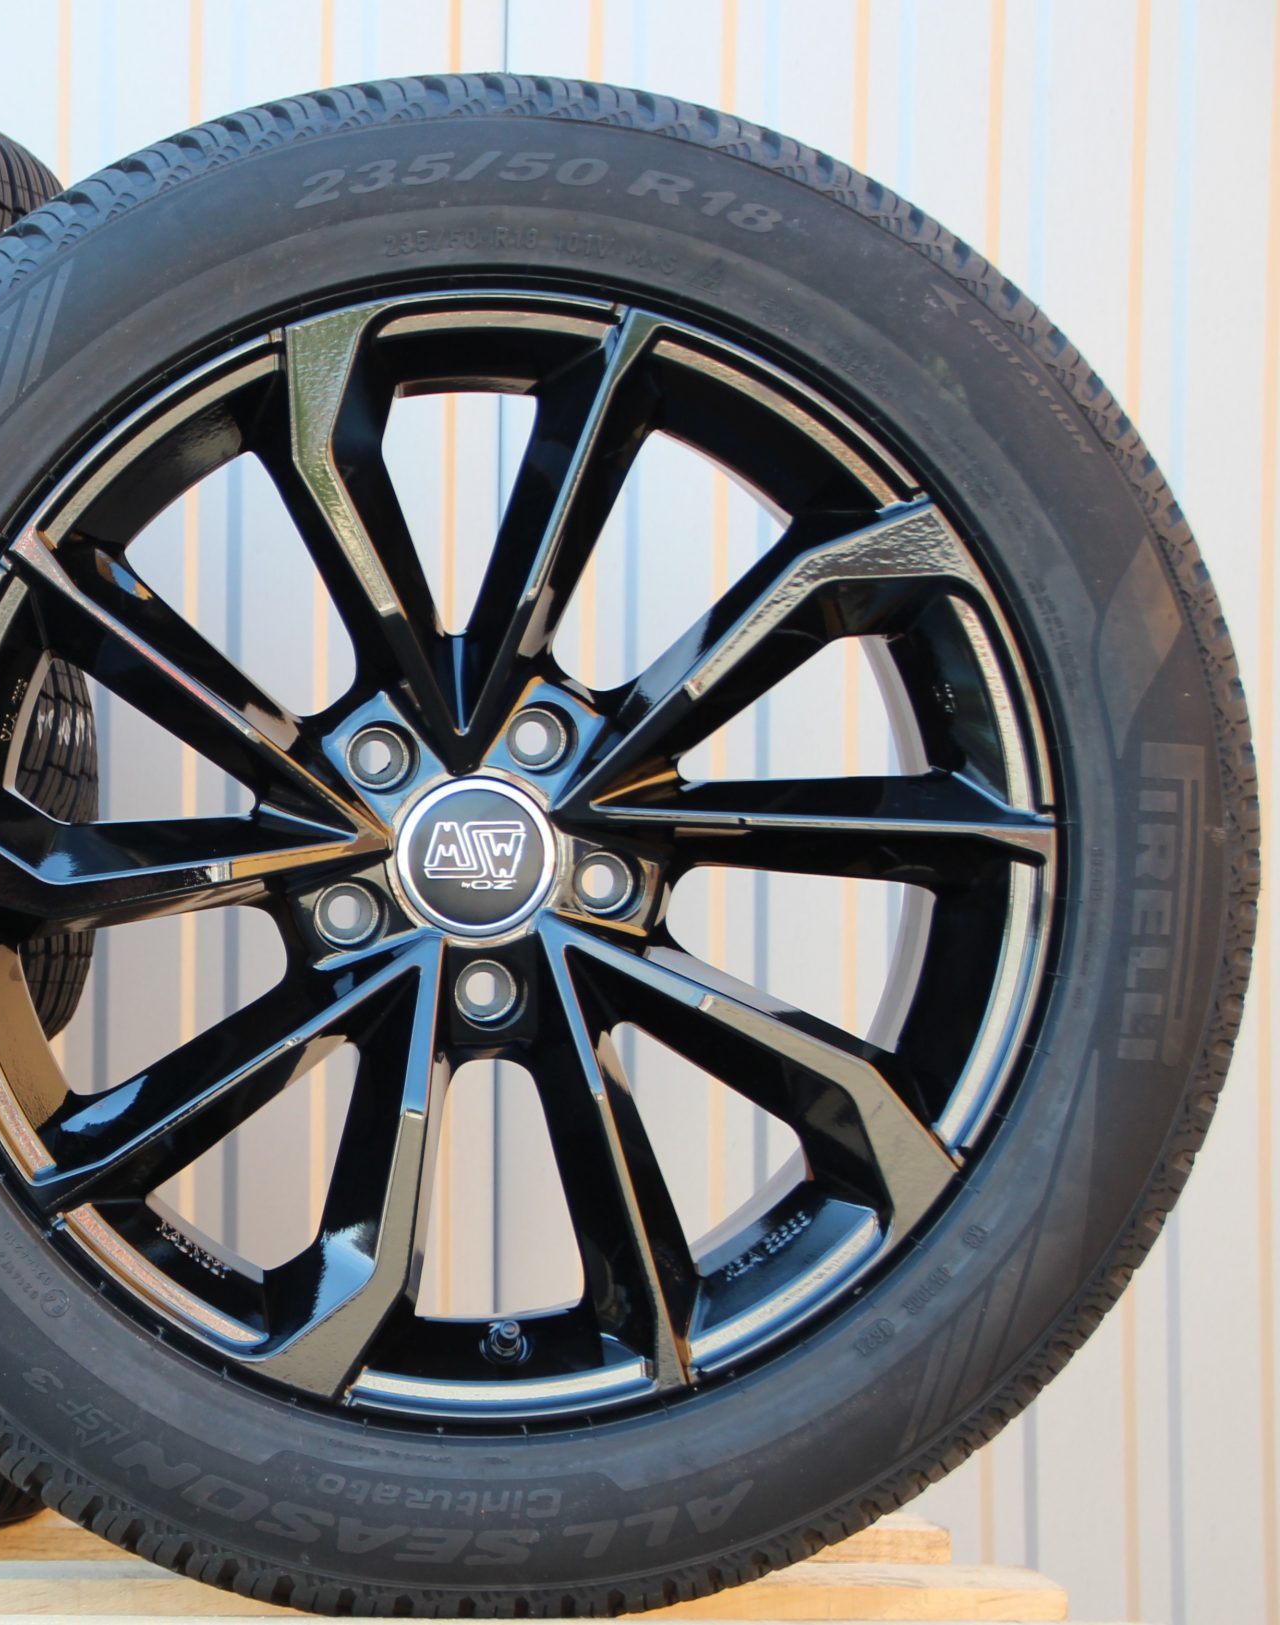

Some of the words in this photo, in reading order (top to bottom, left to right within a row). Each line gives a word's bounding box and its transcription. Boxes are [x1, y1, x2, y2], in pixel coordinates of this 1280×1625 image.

[294, 150, 609, 209] 235/50
[626, 169, 783, 233] R18
[970, 318, 1094, 455] ROTATION
[424, 820, 527, 879] MSW
[1117, 741, 1207, 1067] PIRELLI
[21, 1367, 65, 1394] 3
[113, 1440, 534, 1567] SEASON
[318, 1471, 563, 1519] Cinturato
[563, 1479, 754, 1558] ALL
